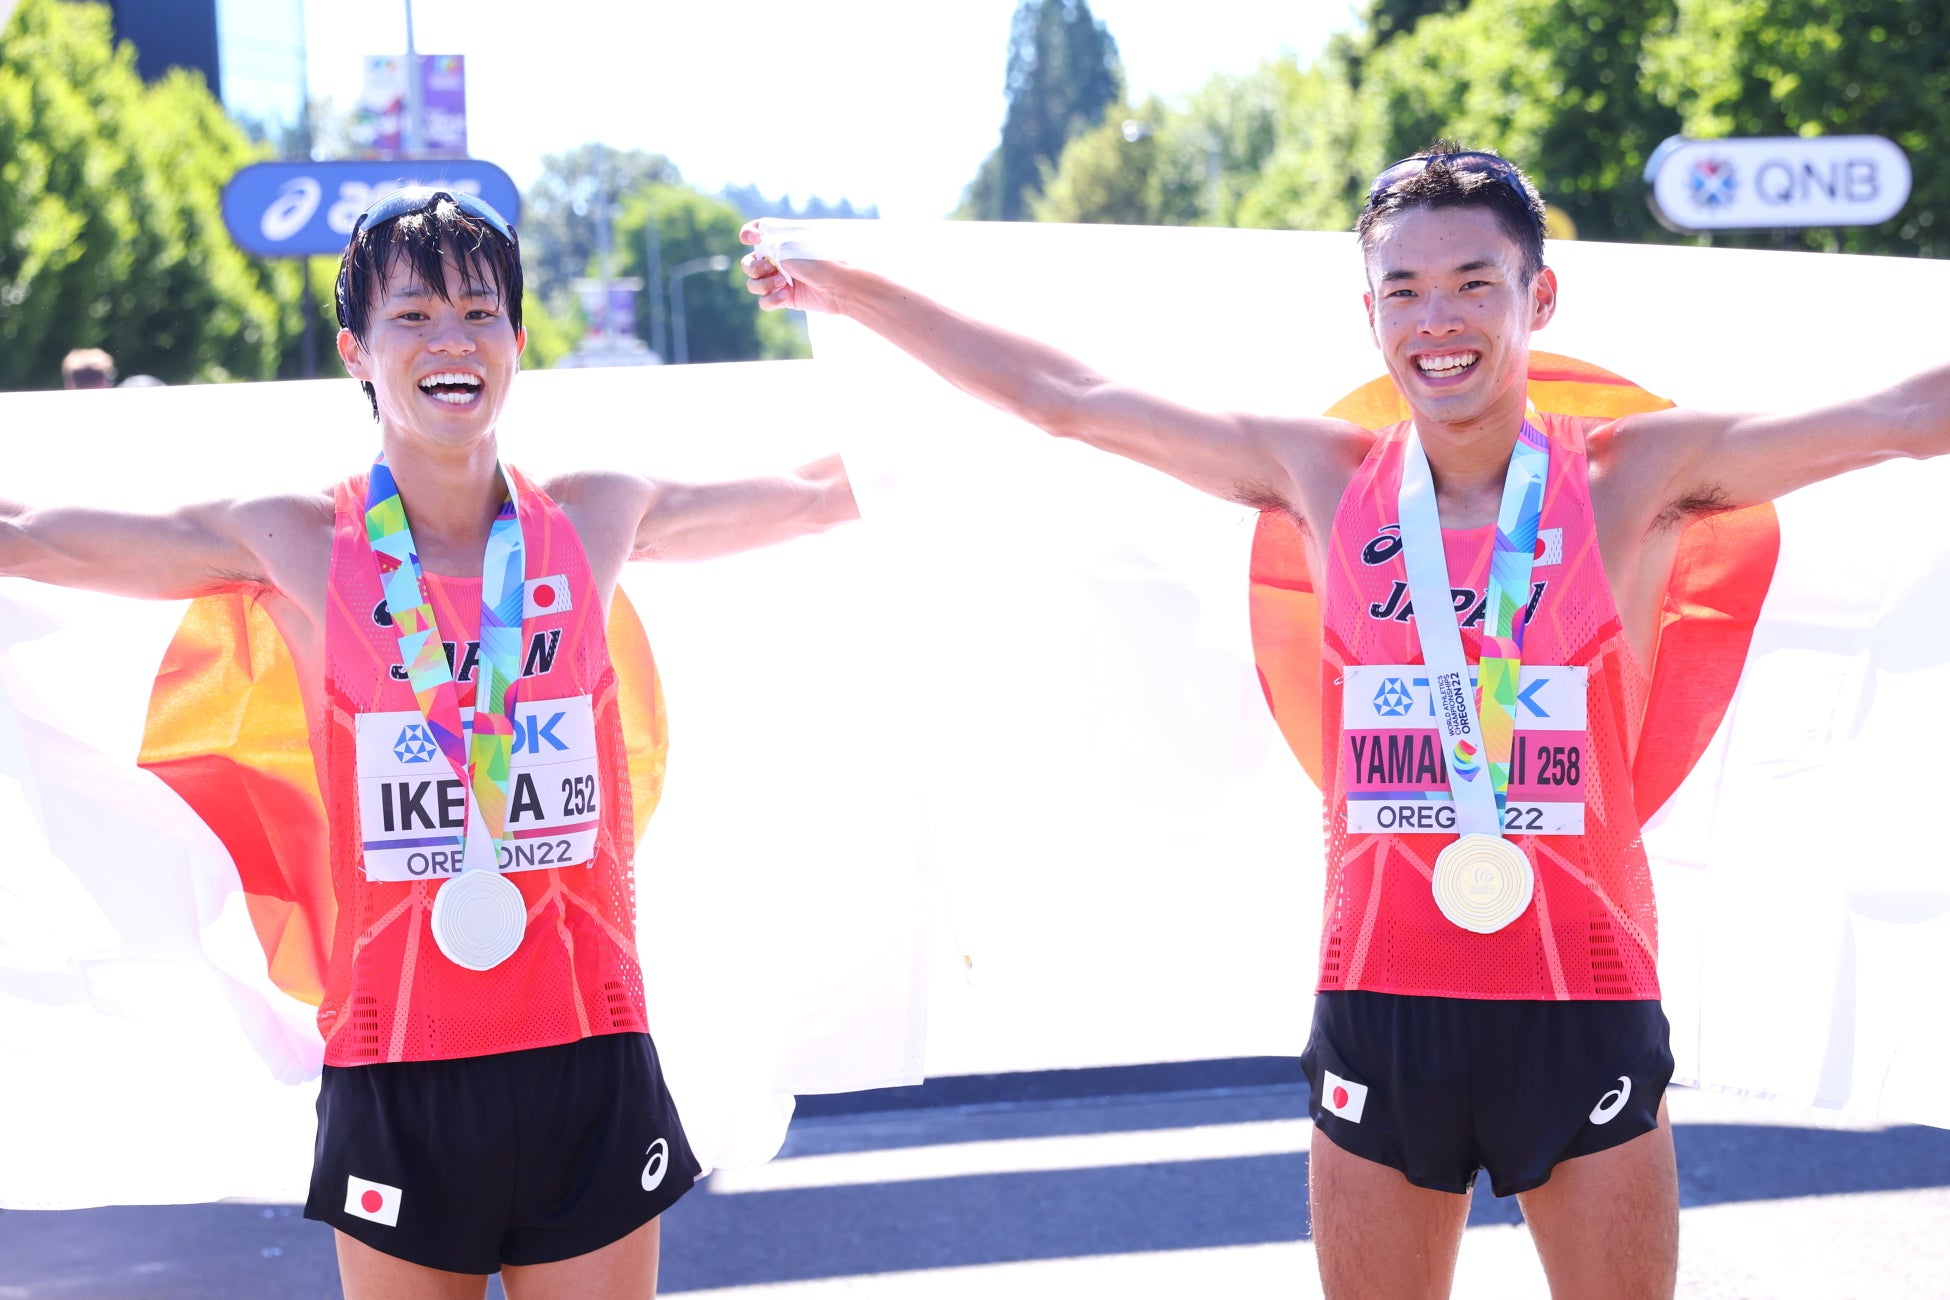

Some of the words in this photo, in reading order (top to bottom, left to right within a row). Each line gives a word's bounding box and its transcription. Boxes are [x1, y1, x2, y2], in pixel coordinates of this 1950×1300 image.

[1756, 162, 1877, 205] QNB
[1437, 674, 1449, 711] ATHLETICS
[1444, 673, 1462, 736] CHAMPIONSHIPS
[1445, 712, 1455, 737] WORLD
[1537, 745, 1580, 786] 258
[381, 773, 545, 832] IKEA
[561, 774, 596, 817] 252
[1377, 805, 1544, 830] OREG22
[407, 840, 573, 876] OREON22
